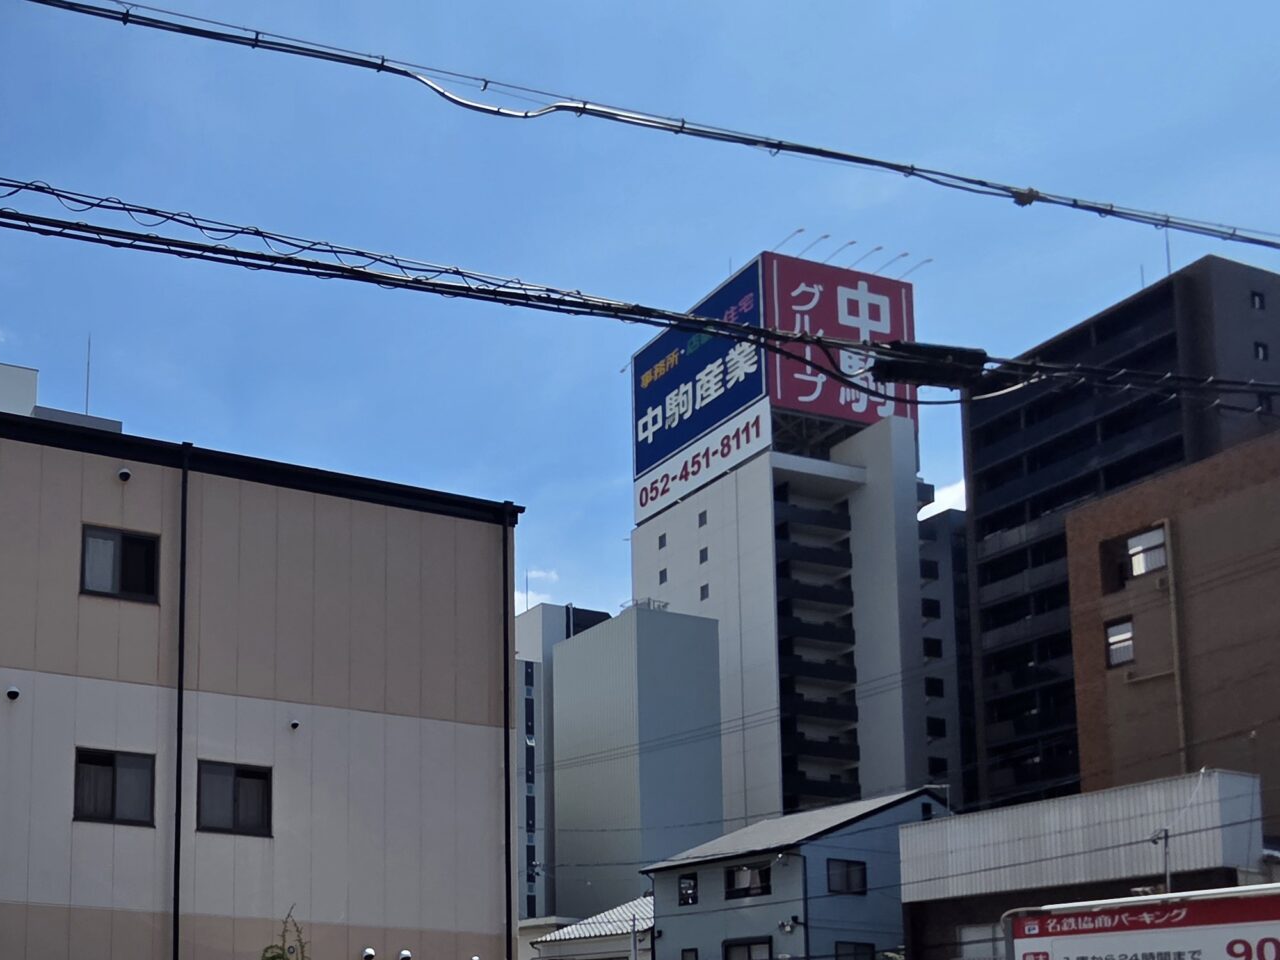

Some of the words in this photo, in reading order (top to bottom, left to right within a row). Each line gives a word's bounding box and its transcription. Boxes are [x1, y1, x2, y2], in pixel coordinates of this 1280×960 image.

[790, 282, 827, 402] グループ
[637, 340, 759, 444] 中駒産業
[639, 414, 761, 508] 052-451-8111
[1046, 907, 1188, 933] 名鉄協商パーキング
